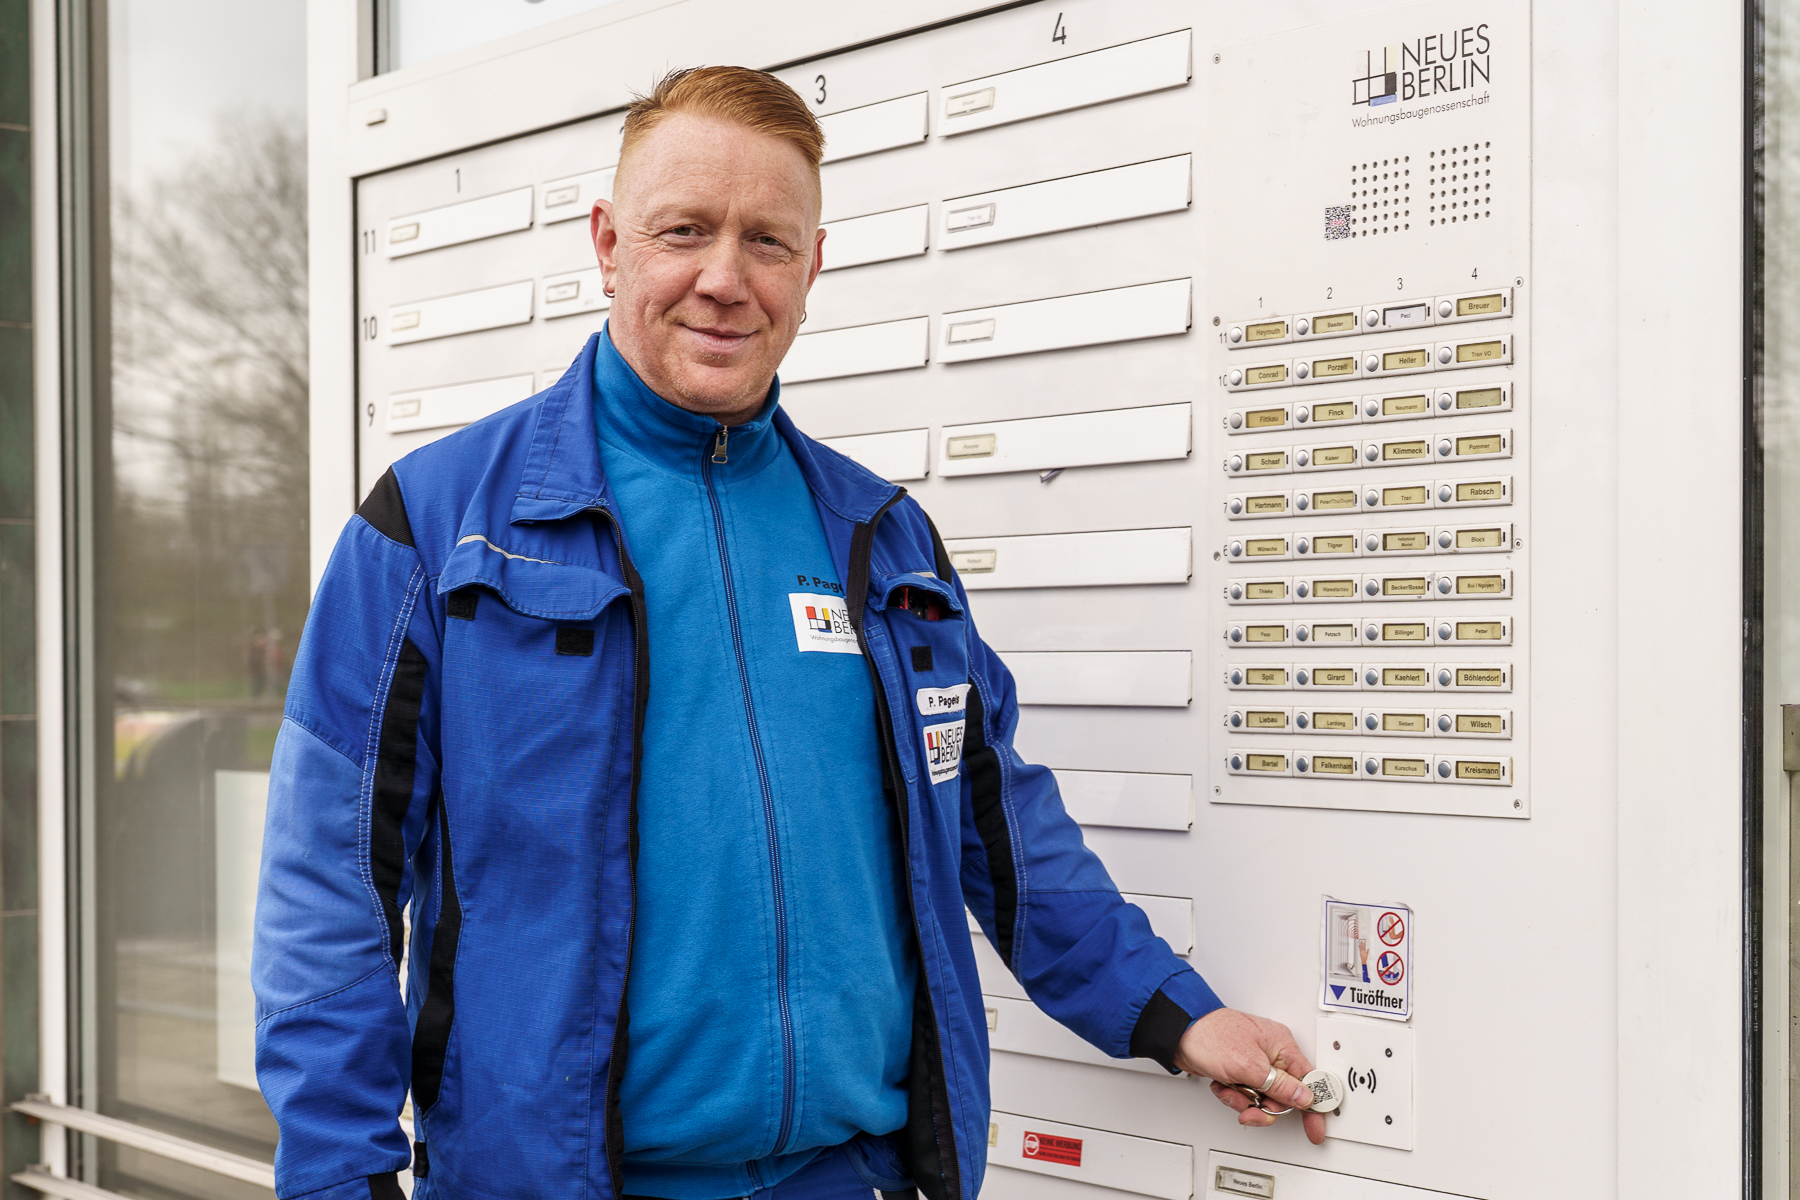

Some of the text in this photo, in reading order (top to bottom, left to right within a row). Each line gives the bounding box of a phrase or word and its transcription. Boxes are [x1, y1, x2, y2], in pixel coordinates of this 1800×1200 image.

[1052, 12, 1067, 45] 4
[1402, 23, 1490, 71] NEUES
[1402, 54, 1490, 101] BERLIN
[815, 74, 827, 105] 3
[1351, 90, 1490, 128] Wohnungsbaugenossenschaft
[455, 167, 461, 193] 1
[364, 228, 376, 255] 11
[1471, 267, 1478, 280] 4
[1397, 277, 1403, 290] 3
[1326, 286, 1333, 300] 2
[1258, 296, 1263, 308] 1
[1468, 302, 1490, 310] Breuer
[363, 315, 378, 342] 10
[1327, 320, 1344, 328] Baader
[1256, 328, 1281, 337] Heymuth
[1399, 356, 1417, 365] Heller
[1258, 371, 1279, 379] Conrad
[367, 402, 375, 427] 9
[1392, 446, 1423, 455] Klimmeck
[1260, 457, 1281, 466] Schaaf
[1470, 488, 1495, 496] Rabsch
[797, 574, 811, 587] P.
[1394, 629, 1415, 637] Billinger
[1326, 673, 1346, 682] Girard
[1463, 673, 1500, 682] Böhlendorf
[928, 696, 937, 708] P.
[1258, 716, 1278, 724] Liebau
[1470, 720, 1493, 729] Wilsch
[940, 726, 964, 747] NEUES
[1261, 760, 1279, 768] Bartel
[1464, 766, 1500, 775] Kreismann
[1350, 986, 1404, 1010] Türöffner
[1232, 1178, 1248, 1187] Neues
